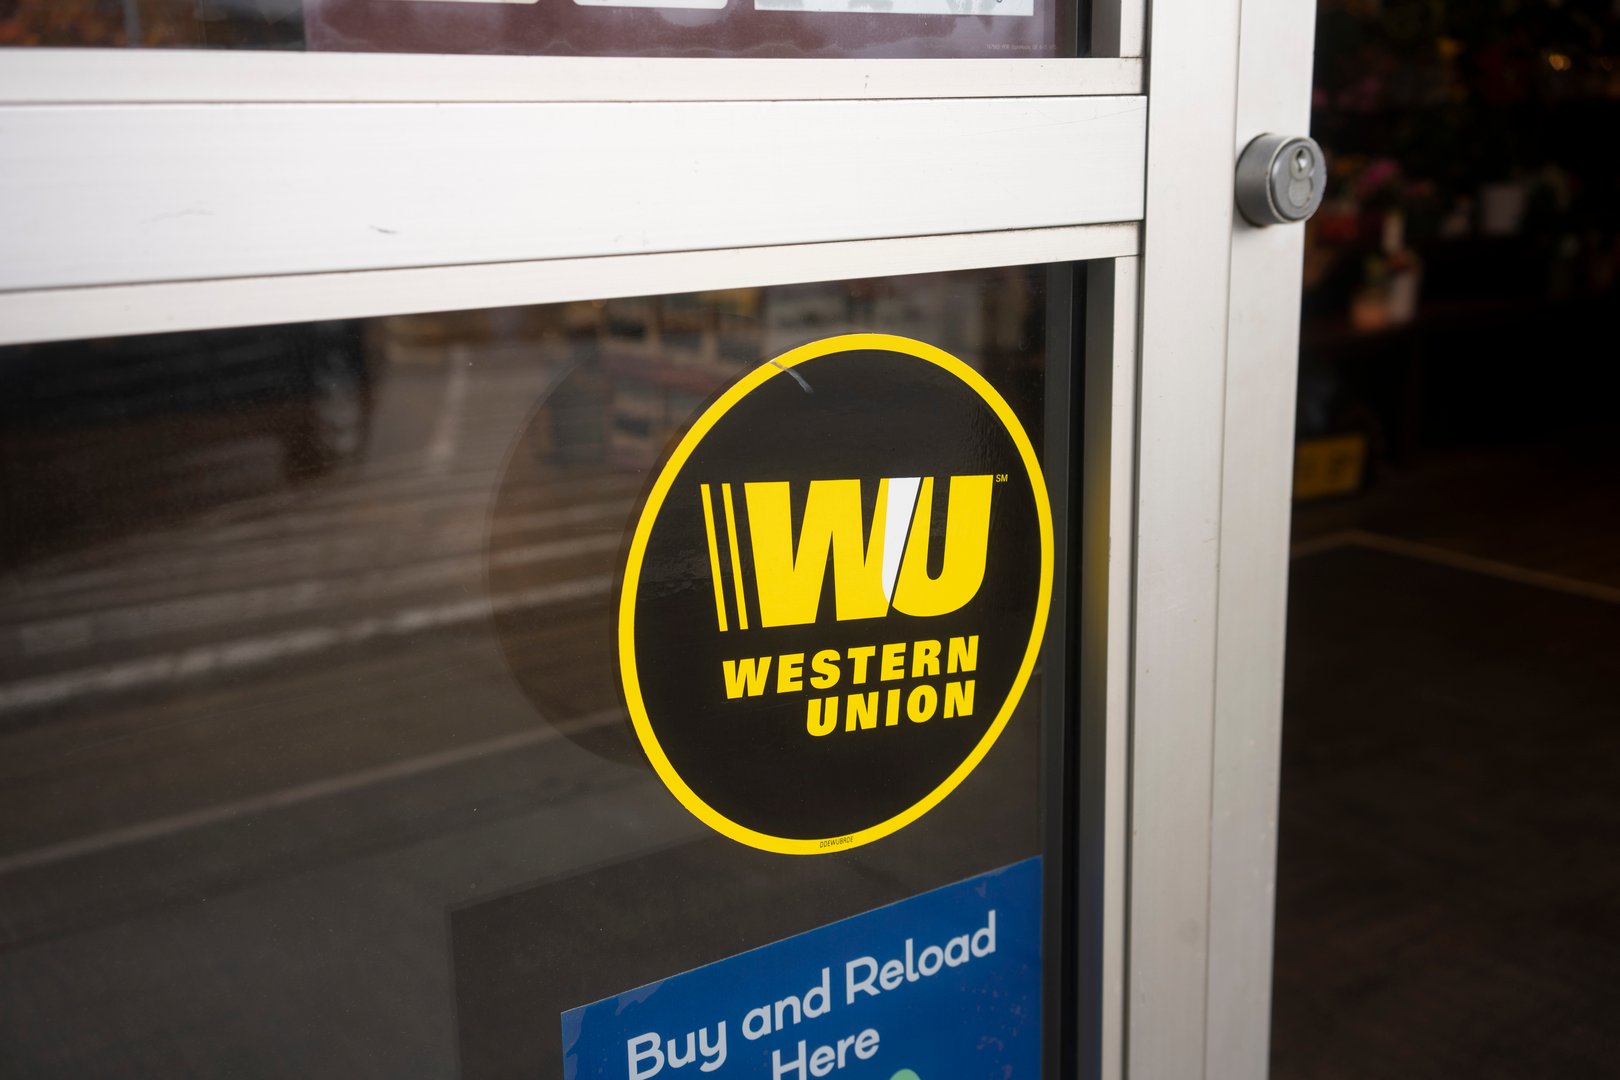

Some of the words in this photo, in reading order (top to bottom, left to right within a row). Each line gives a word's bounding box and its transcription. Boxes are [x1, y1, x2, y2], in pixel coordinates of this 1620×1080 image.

[744, 474, 993, 628] WU
[995, 473, 1009, 483] SM
[722, 635, 980, 699] WESTERN
[806, 679, 976, 737] UNION
[627, 1020, 727, 1080] Buy
[741, 967, 832, 1041] and
[845, 909, 997, 1005] Reload
[772, 1028, 880, 1080] Here
